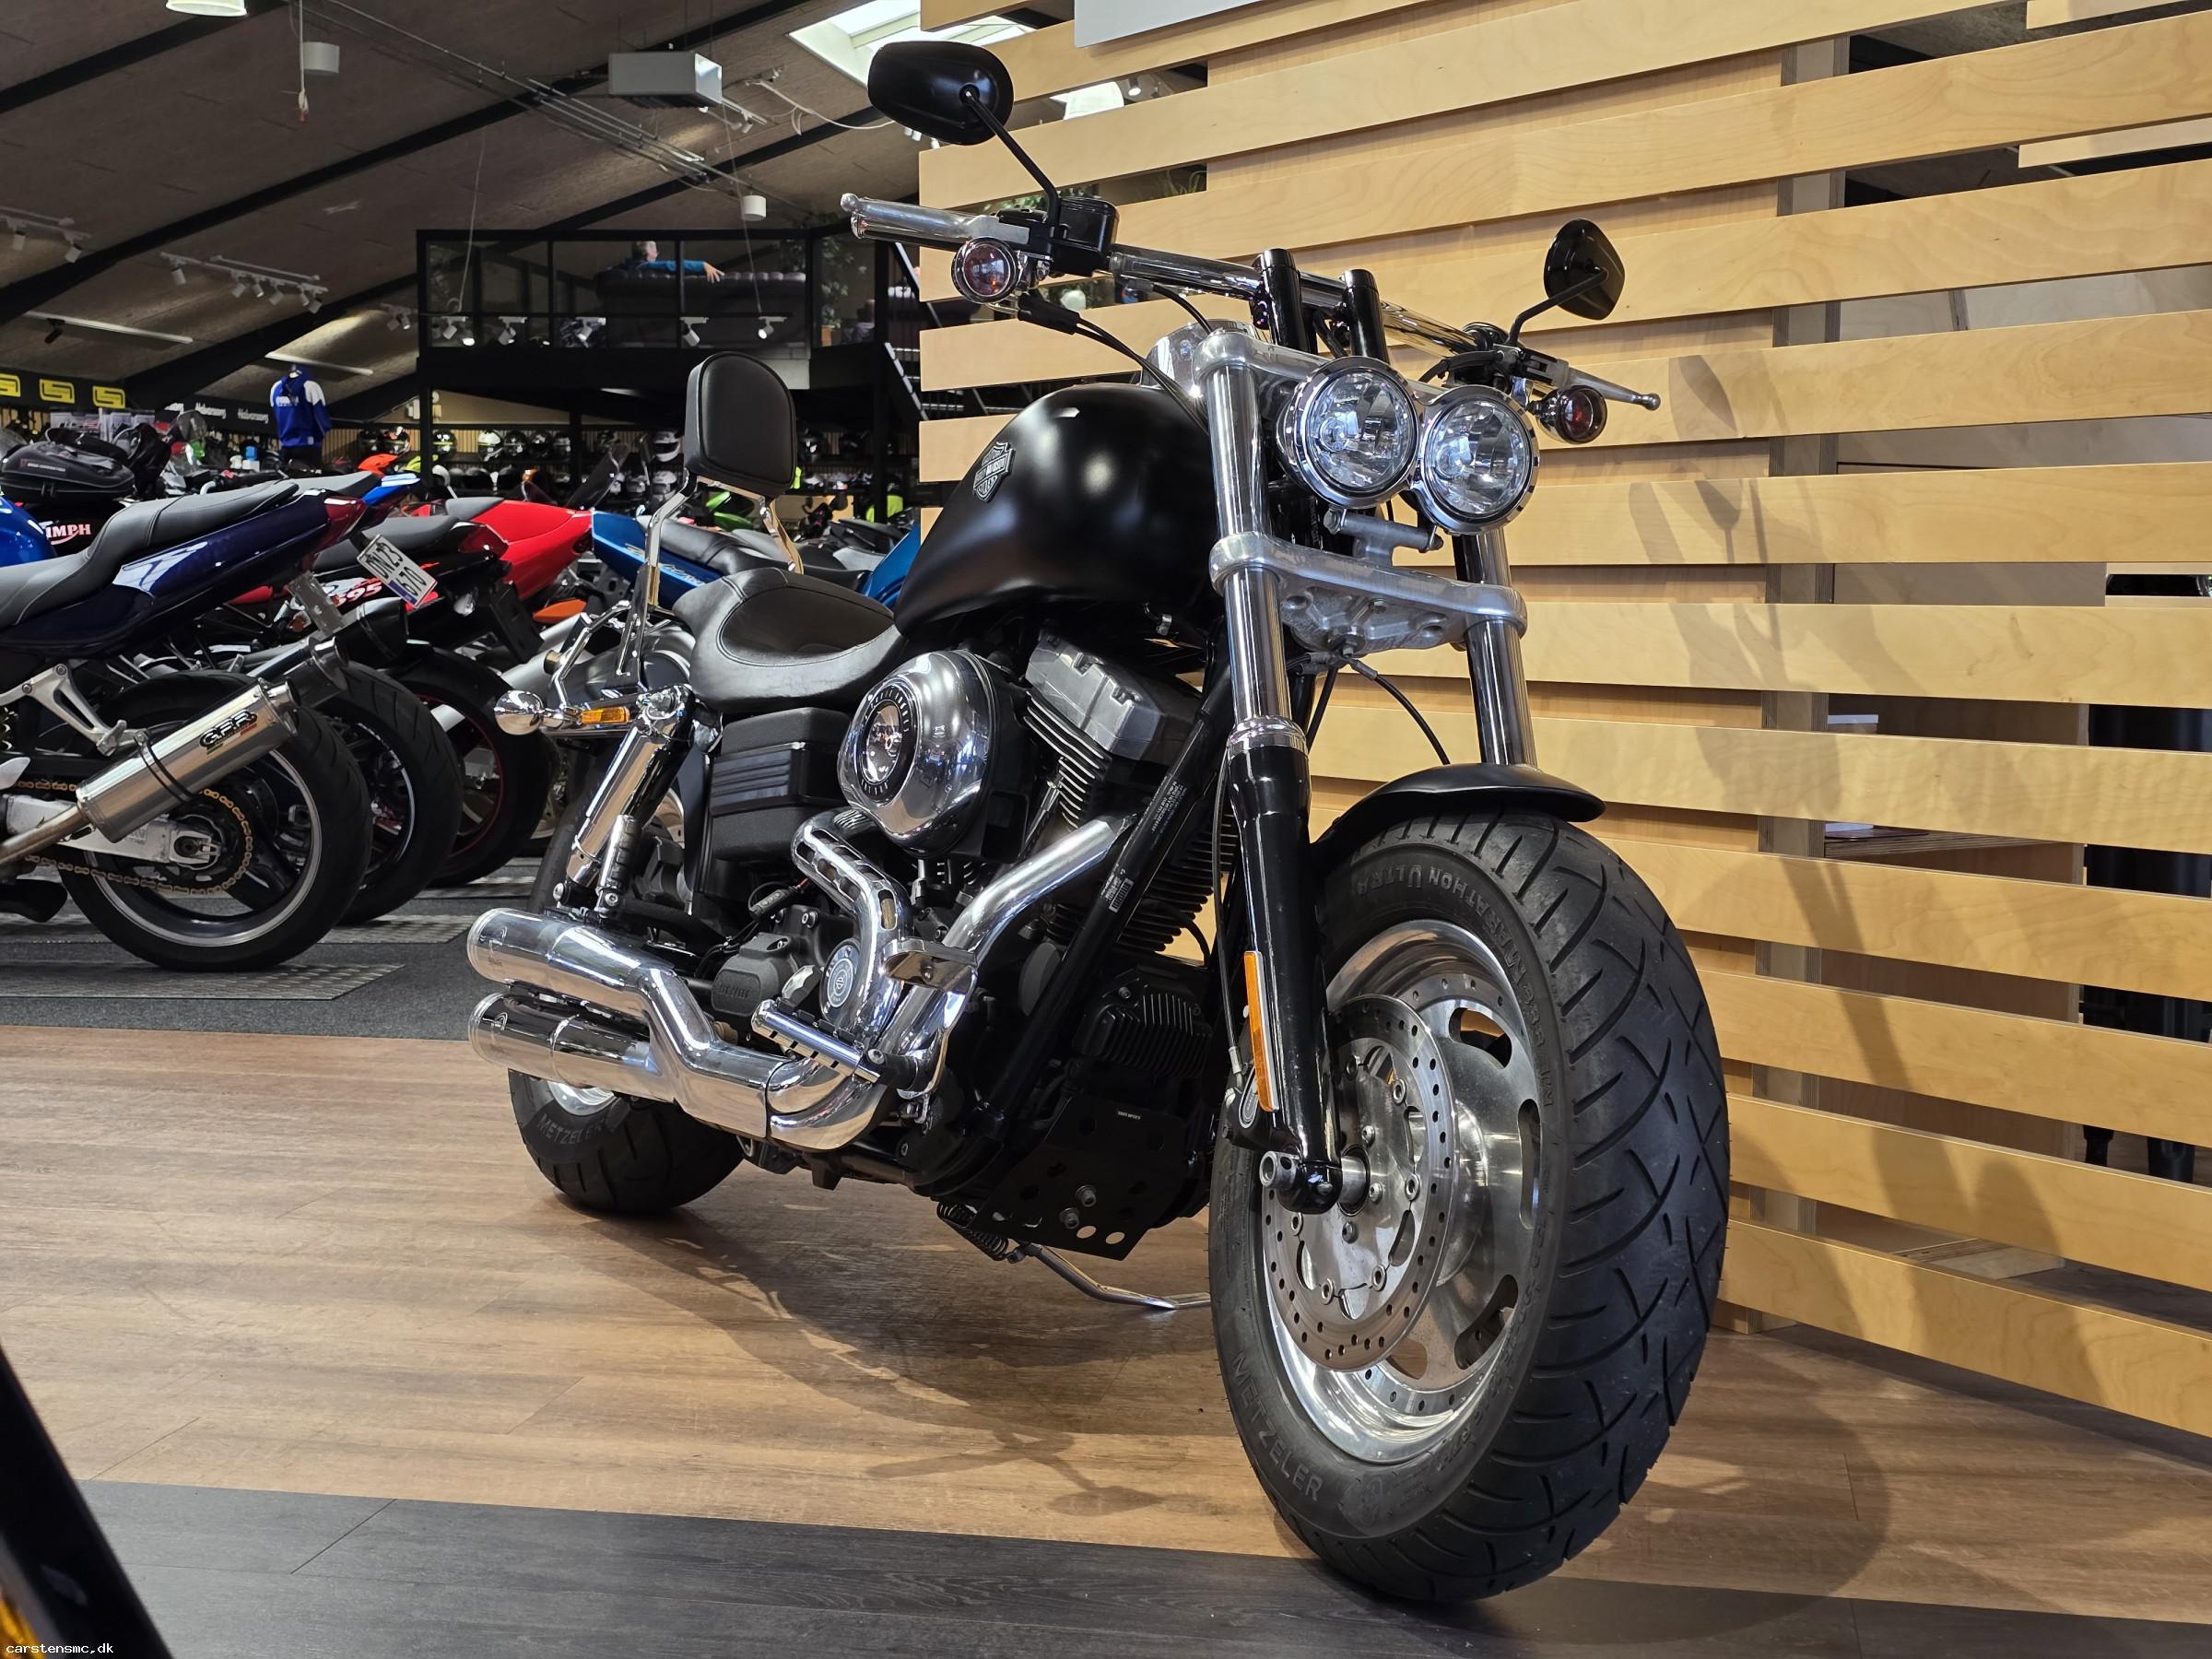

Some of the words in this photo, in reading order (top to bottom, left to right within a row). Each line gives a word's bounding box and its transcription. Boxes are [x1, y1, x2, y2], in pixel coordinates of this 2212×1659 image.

[395, 566, 427, 596] 670
[1357, 864, 1422, 895] ULTRA
[1429, 865, 1527, 984] MARATHON
[1232, 1351, 1324, 1503] METZELER
